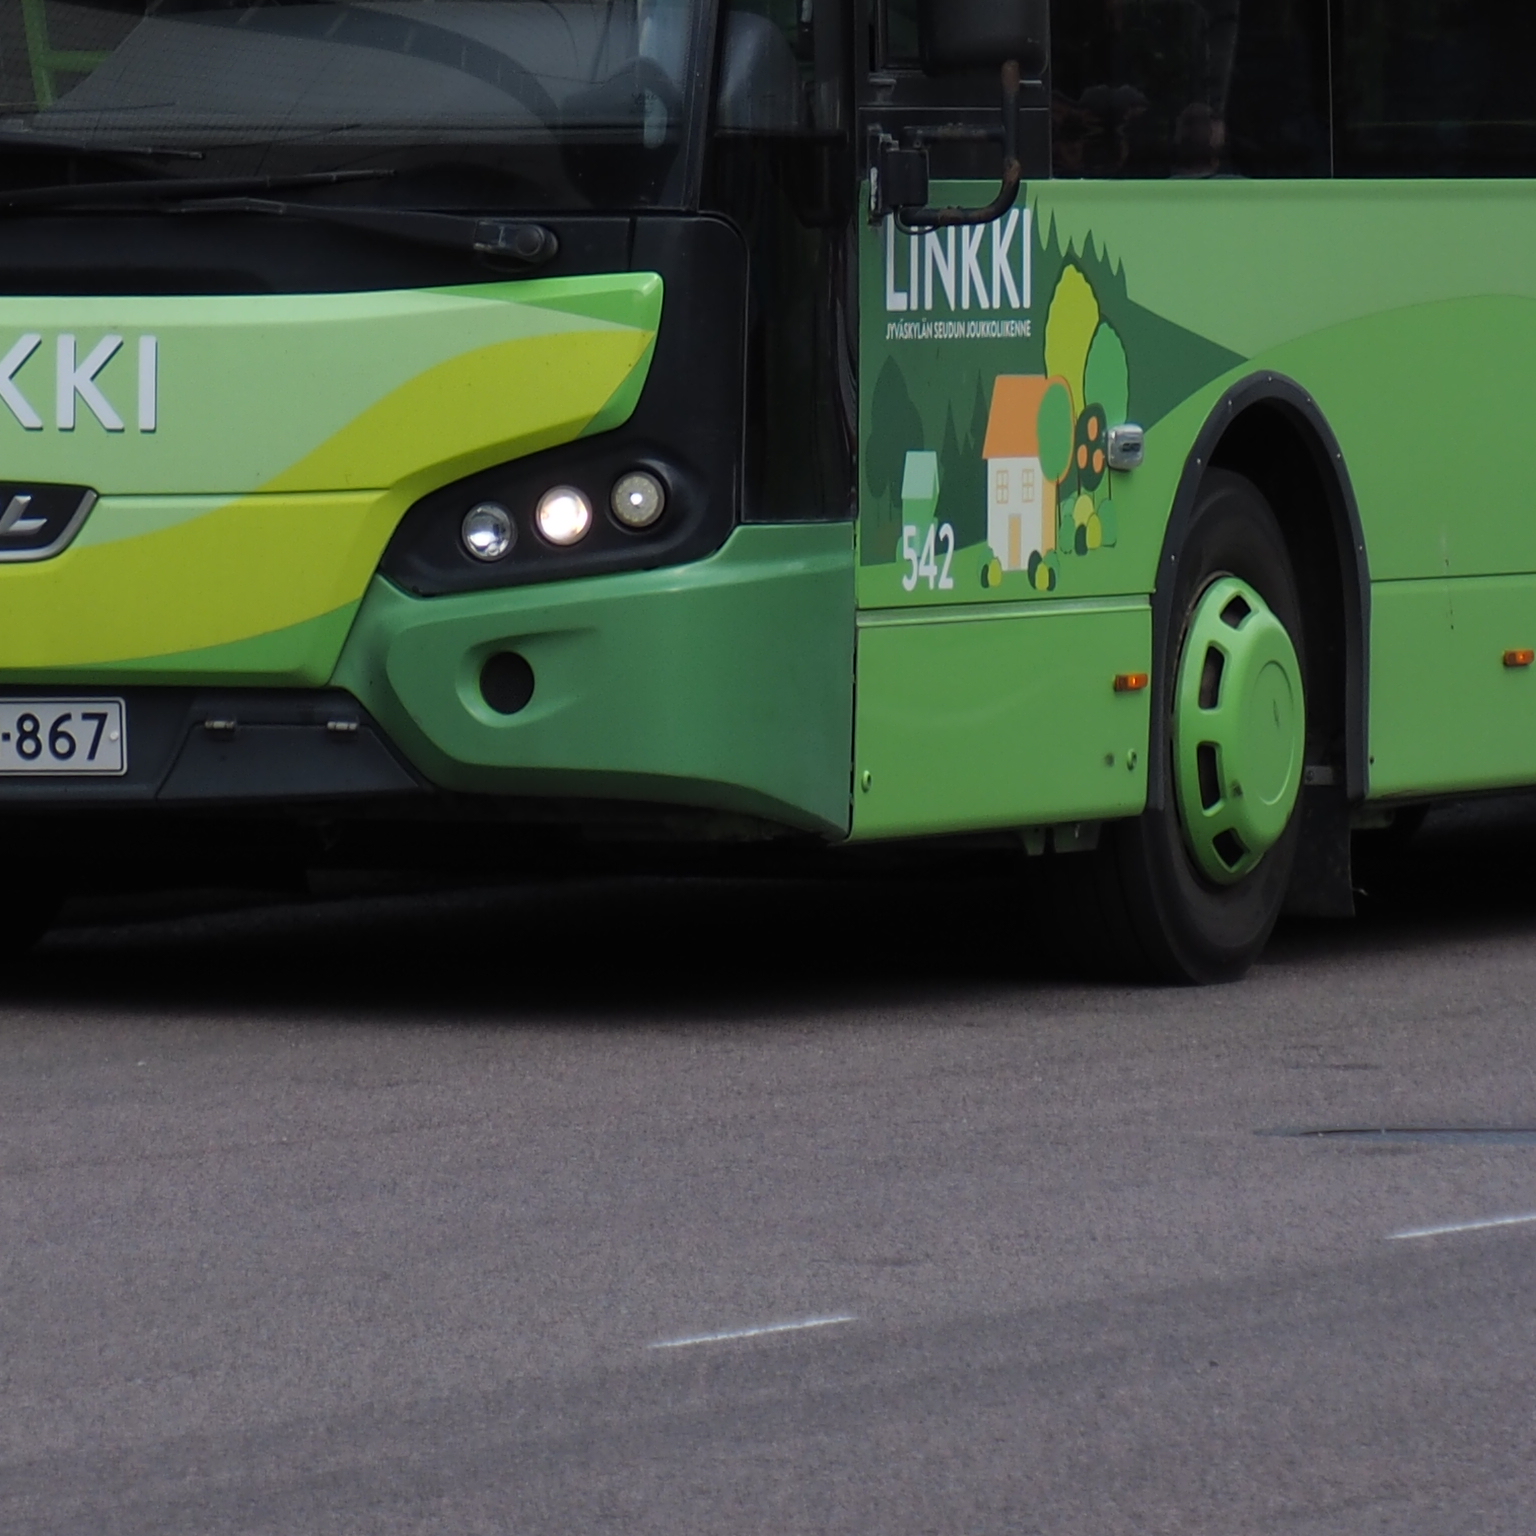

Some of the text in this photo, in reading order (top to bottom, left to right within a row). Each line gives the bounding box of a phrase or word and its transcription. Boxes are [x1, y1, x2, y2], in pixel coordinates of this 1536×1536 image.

[886, 208, 1032, 312] LINKKI
[933, 321, 965, 339] SEUDUN
[965, 319, 1032, 338] JOUKKOLIIKENNE
[902, 522, 955, 591] 542
